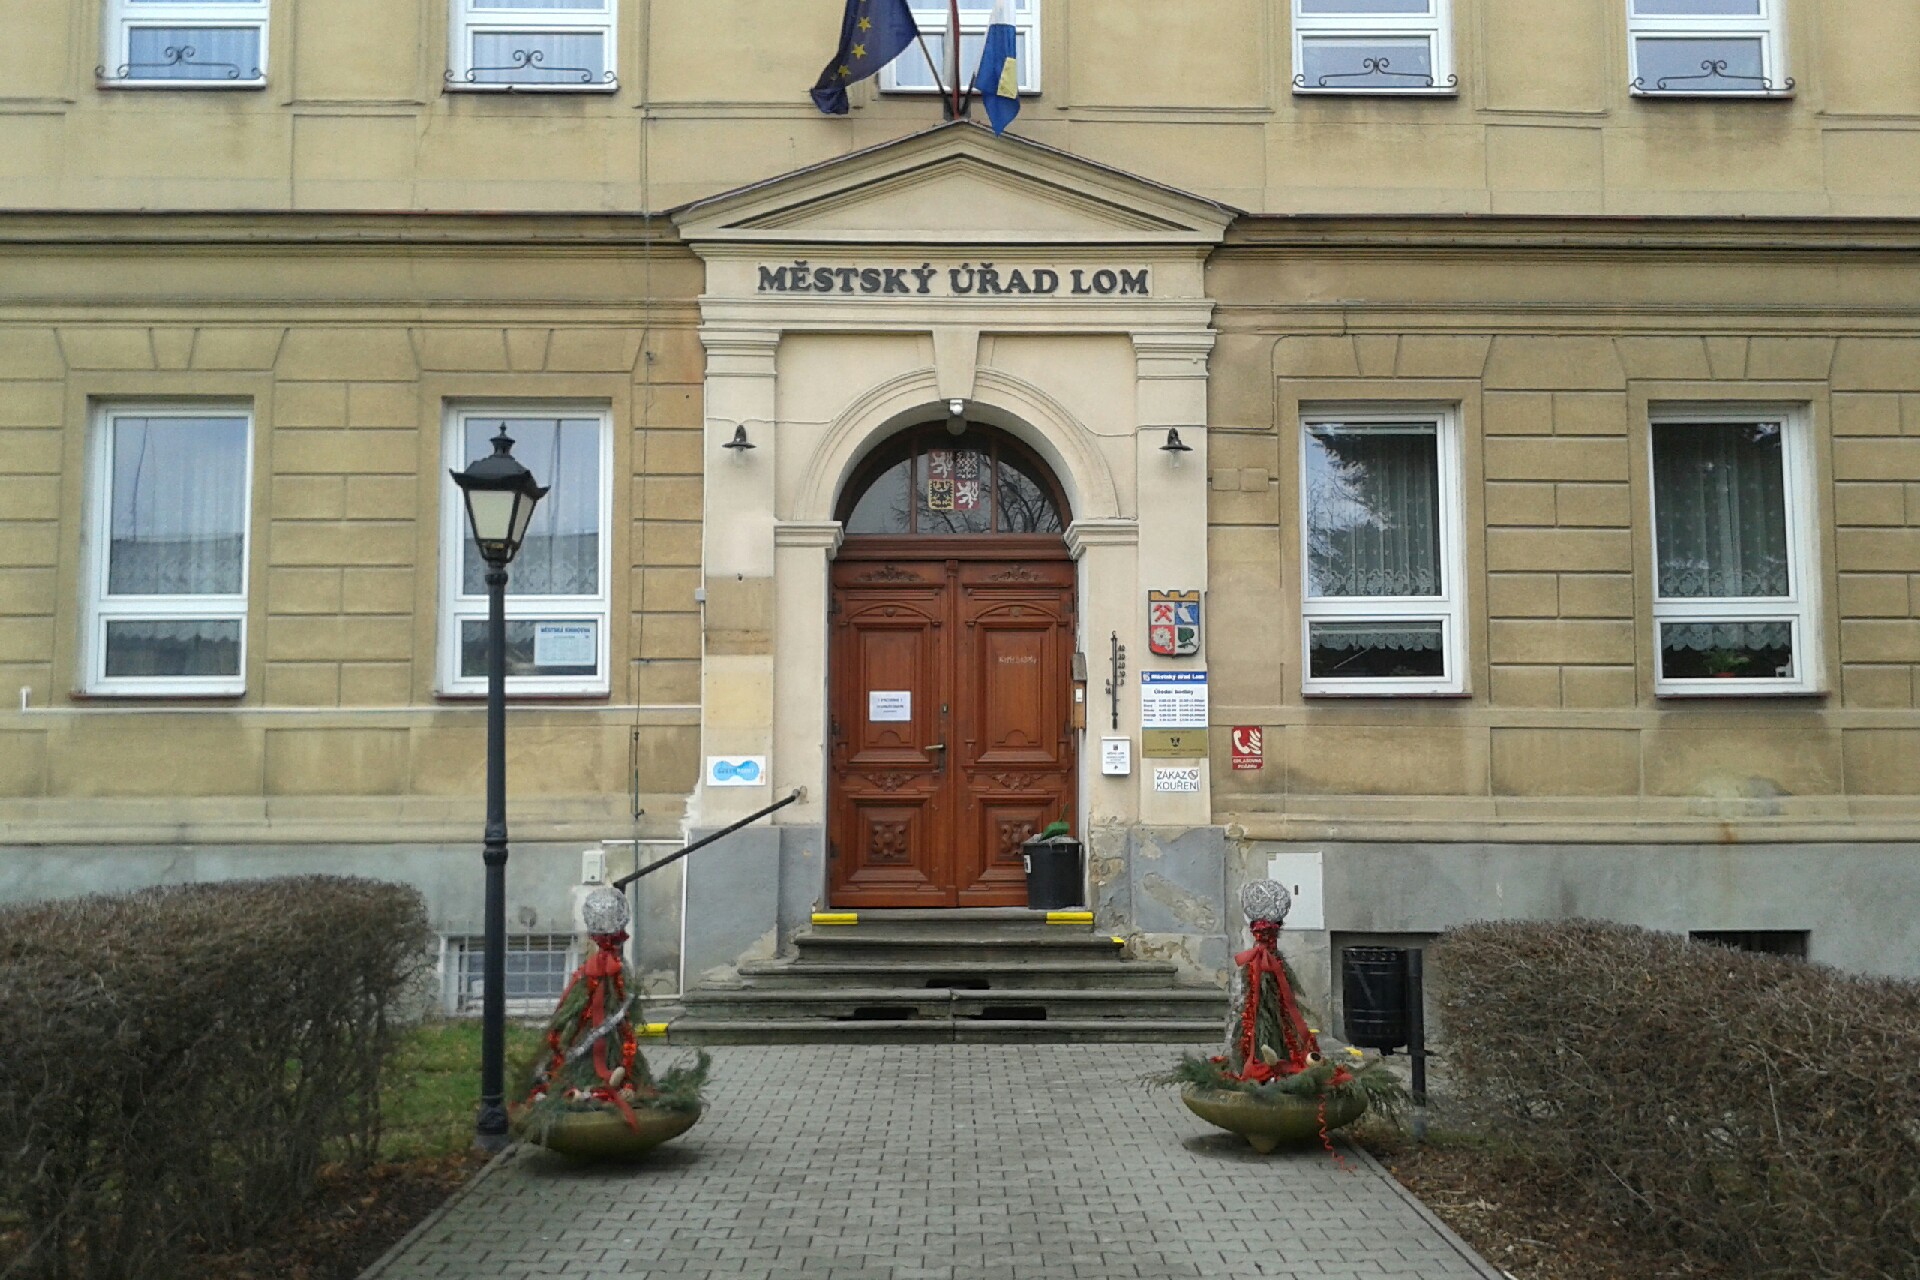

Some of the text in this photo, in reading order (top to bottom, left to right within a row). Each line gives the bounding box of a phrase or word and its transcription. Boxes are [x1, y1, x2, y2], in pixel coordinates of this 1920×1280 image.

[758, 261, 1149, 295] MĚSTSKÝ ÚŘAD LOM
[1156, 769, 1188, 780] ZÁKAZ
